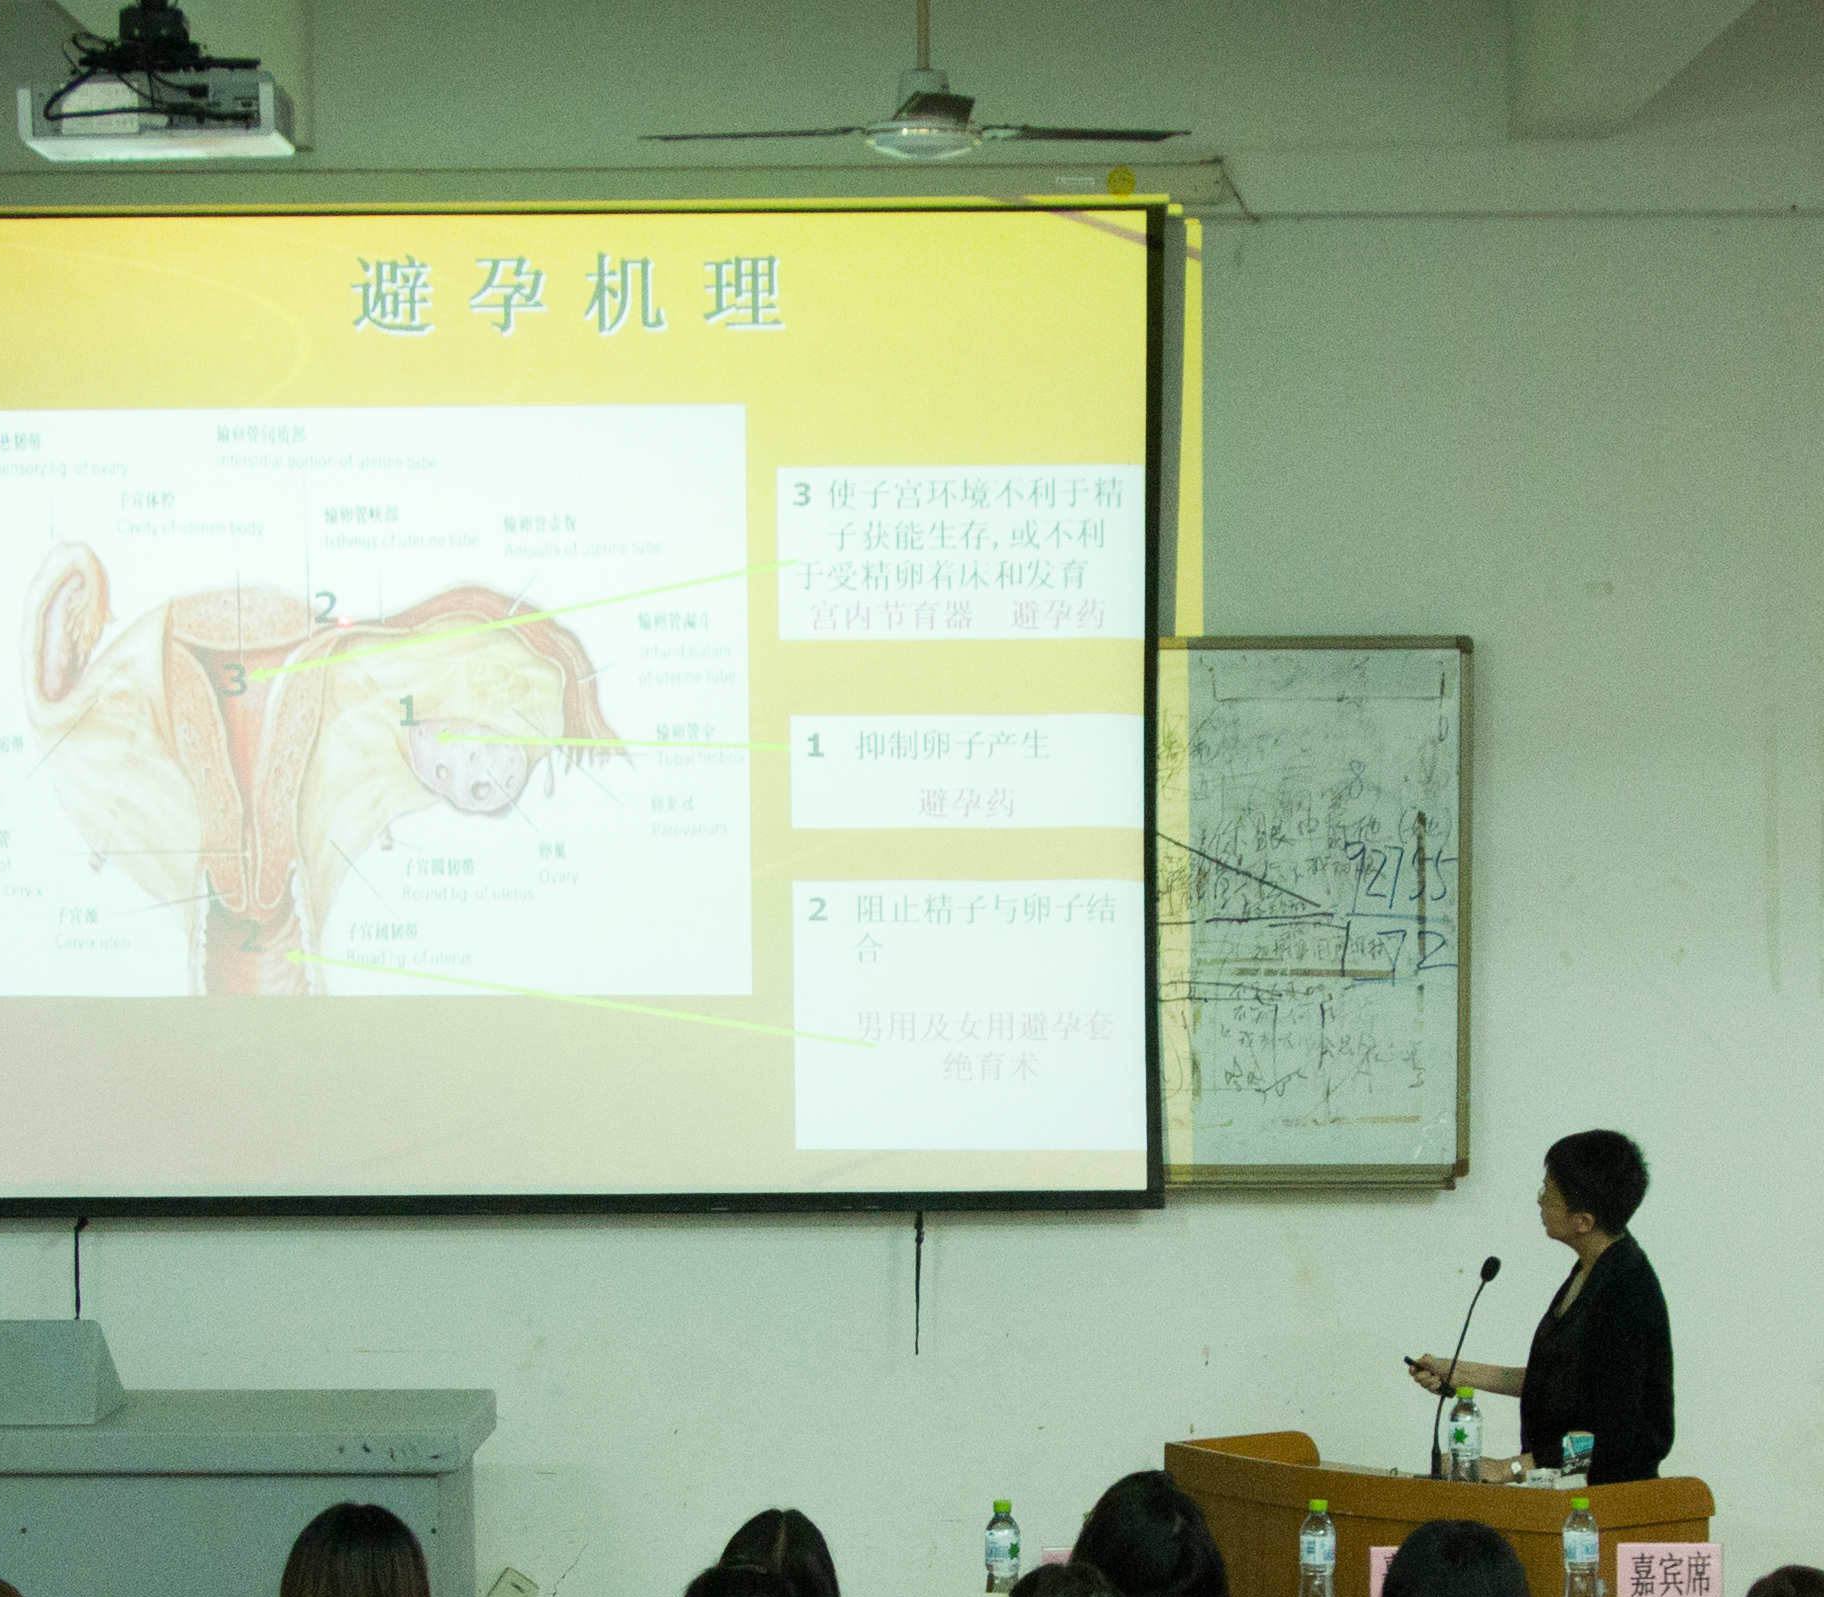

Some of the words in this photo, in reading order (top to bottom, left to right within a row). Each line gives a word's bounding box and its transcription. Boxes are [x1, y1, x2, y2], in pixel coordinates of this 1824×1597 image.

[350, 251, 786, 337] 避孕机理
[74, 460, 88, 476] of
[91, 461, 128, 477] ovary
[287, 454, 336, 470] portion
[340, 453, 353, 469] of
[357, 455, 403, 470] uterine
[407, 455, 437, 470] tube
[793, 482, 812, 506] 3
[827, 476, 1124, 510] 使子宫环境不利于精
[116, 519, 157, 537] Cavity
[162, 519, 175, 535] of
[179, 521, 226, 535] uterine
[230, 519, 264, 537] body
[325, 534, 377, 549] Isthmus
[382, 533, 395, 549] of
[399, 534, 445, 549] uterine
[449, 533, 479, 548] tube
[503, 541, 561, 559] Ampulla
[564, 541, 577, 557] of
[582, 541, 628, 556] uterine
[631, 540, 662, 555] tube
[795, 559, 1088, 591] 于受精卵着床和发育
[314, 591, 337, 623] 2
[811, 600, 973, 631] 宫内节育器
[1011, 599, 1105, 630] 避孕药
[223, 664, 248, 696] 3
[638, 669, 651, 685] of
[705, 669, 736, 684] tube
[399, 695, 421, 726] 1
[657, 750, 694, 767] Tubal
[807, 732, 825, 758] 1
[855, 729, 1051, 761] 抑制卵子产生
[918, 787, 1015, 819] 避孕药
[538, 868, 579, 885] Ovary
[402, 885, 448, 902] Round
[475, 885, 488, 902] of
[492, 887, 535, 902] uterus
[808, 897, 828, 922] 2
[856, 893, 1116, 924] 阻止精子与卵子结
[54, 934, 96, 951] Cervix
[238, 919, 262, 953] 2
[853, 933, 883, 963] 合
[413, 950, 427, 966] of
[430, 952, 473, 966] uterus
[857, 1010, 1114, 1043] 男用及女用避孕套
[943, 1050, 1039, 1083] 绝育术
[1630, 1551, 1712, 1597] 嘉宾席
